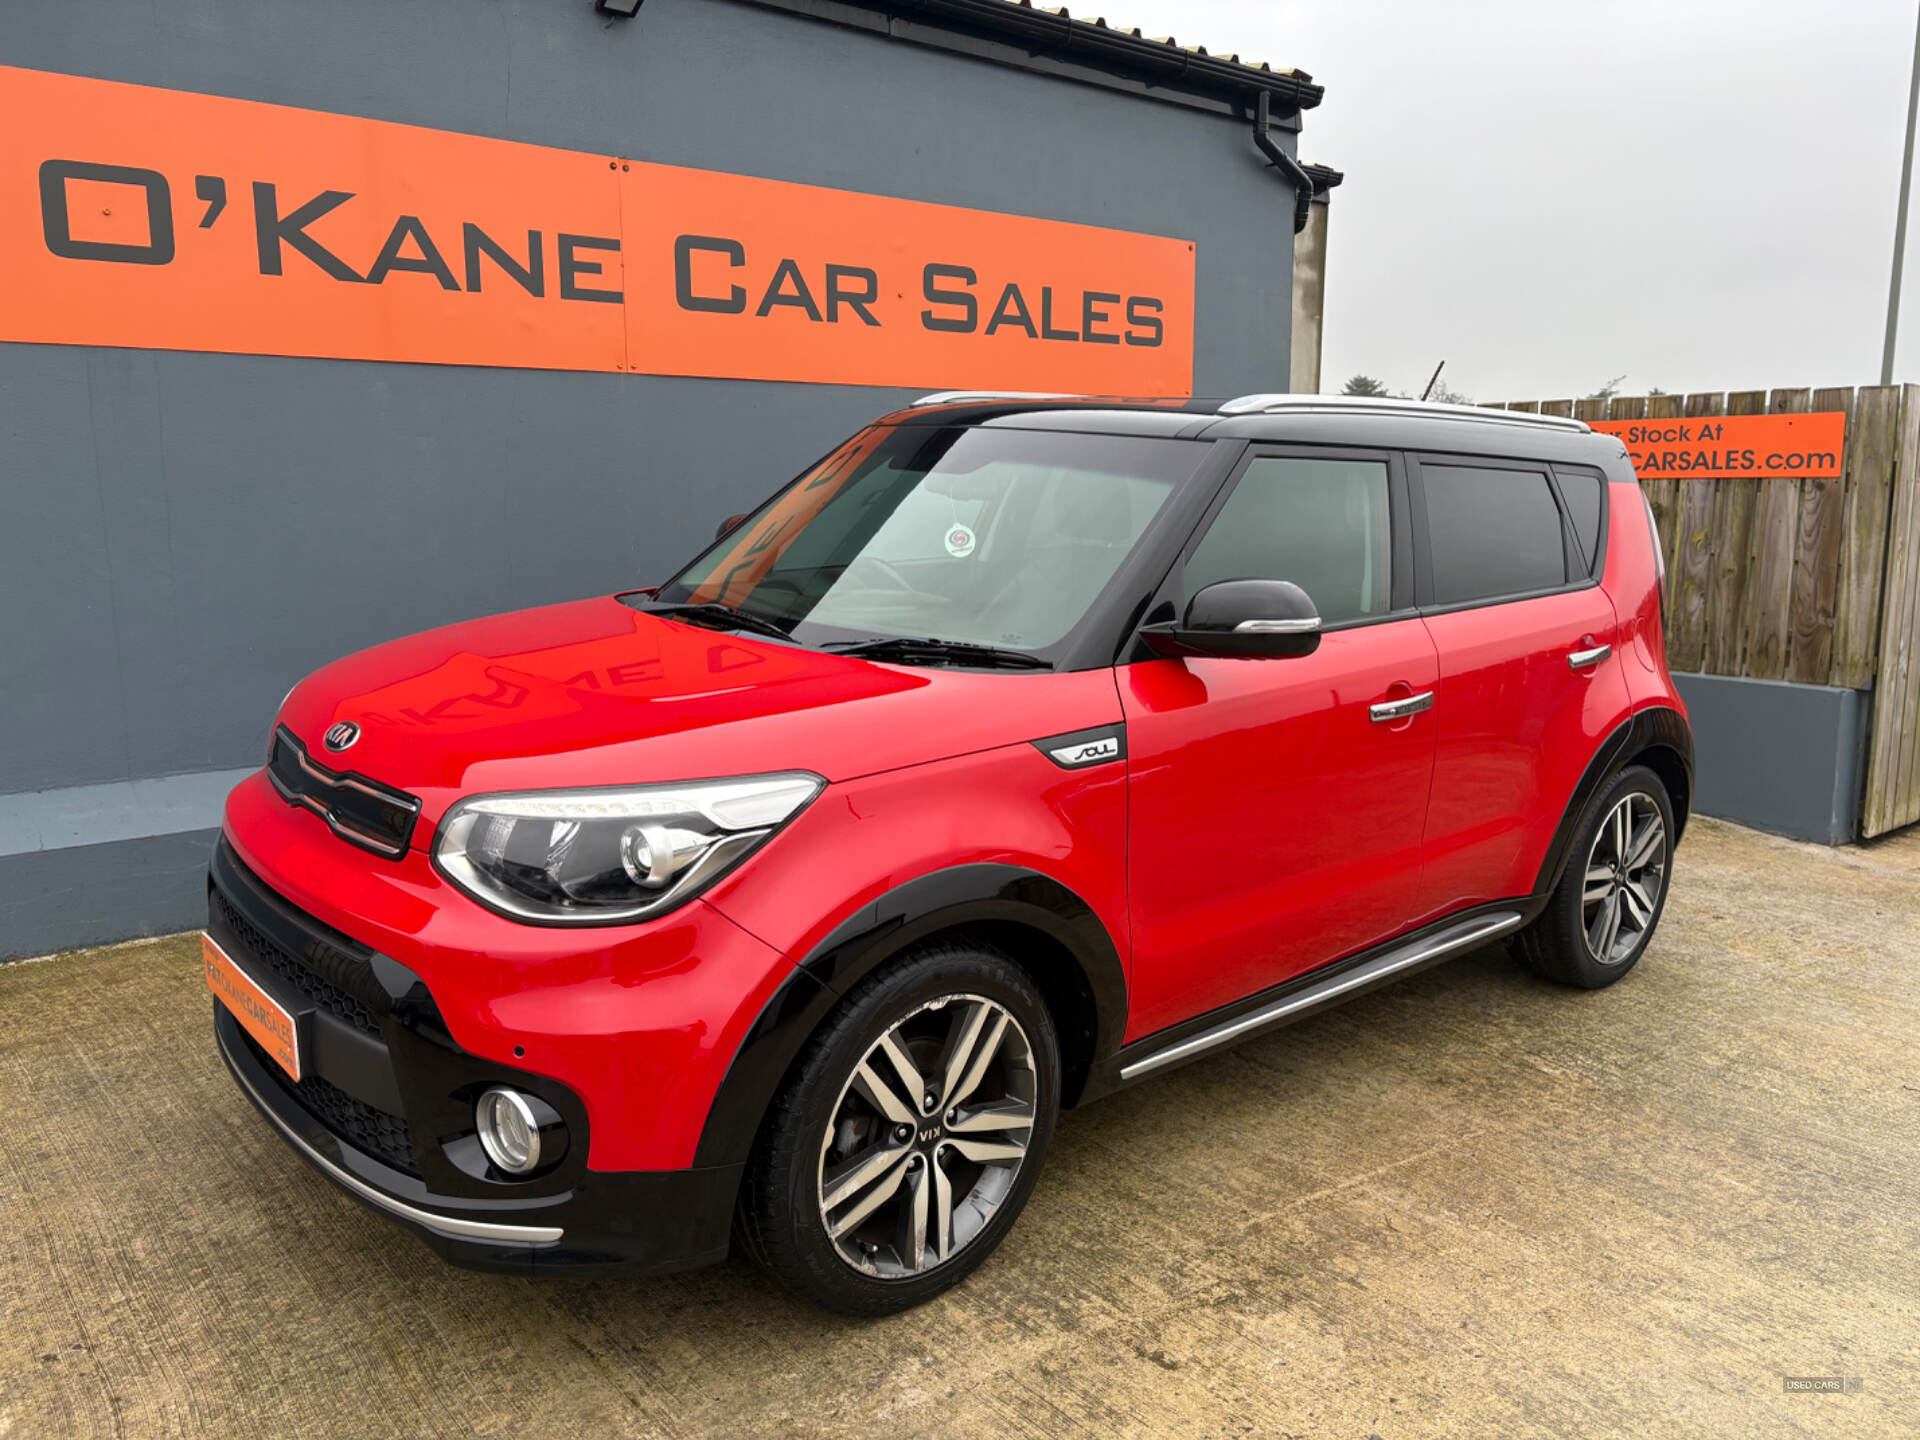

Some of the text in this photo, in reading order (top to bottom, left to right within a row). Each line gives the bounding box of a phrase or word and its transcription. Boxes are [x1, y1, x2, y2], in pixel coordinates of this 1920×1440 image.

[1628, 425, 1690, 444] Stock
[1698, 424, 1723, 441] At
[328, 724, 353, 746] KIA
[919, 1125, 941, 1142] KIA
